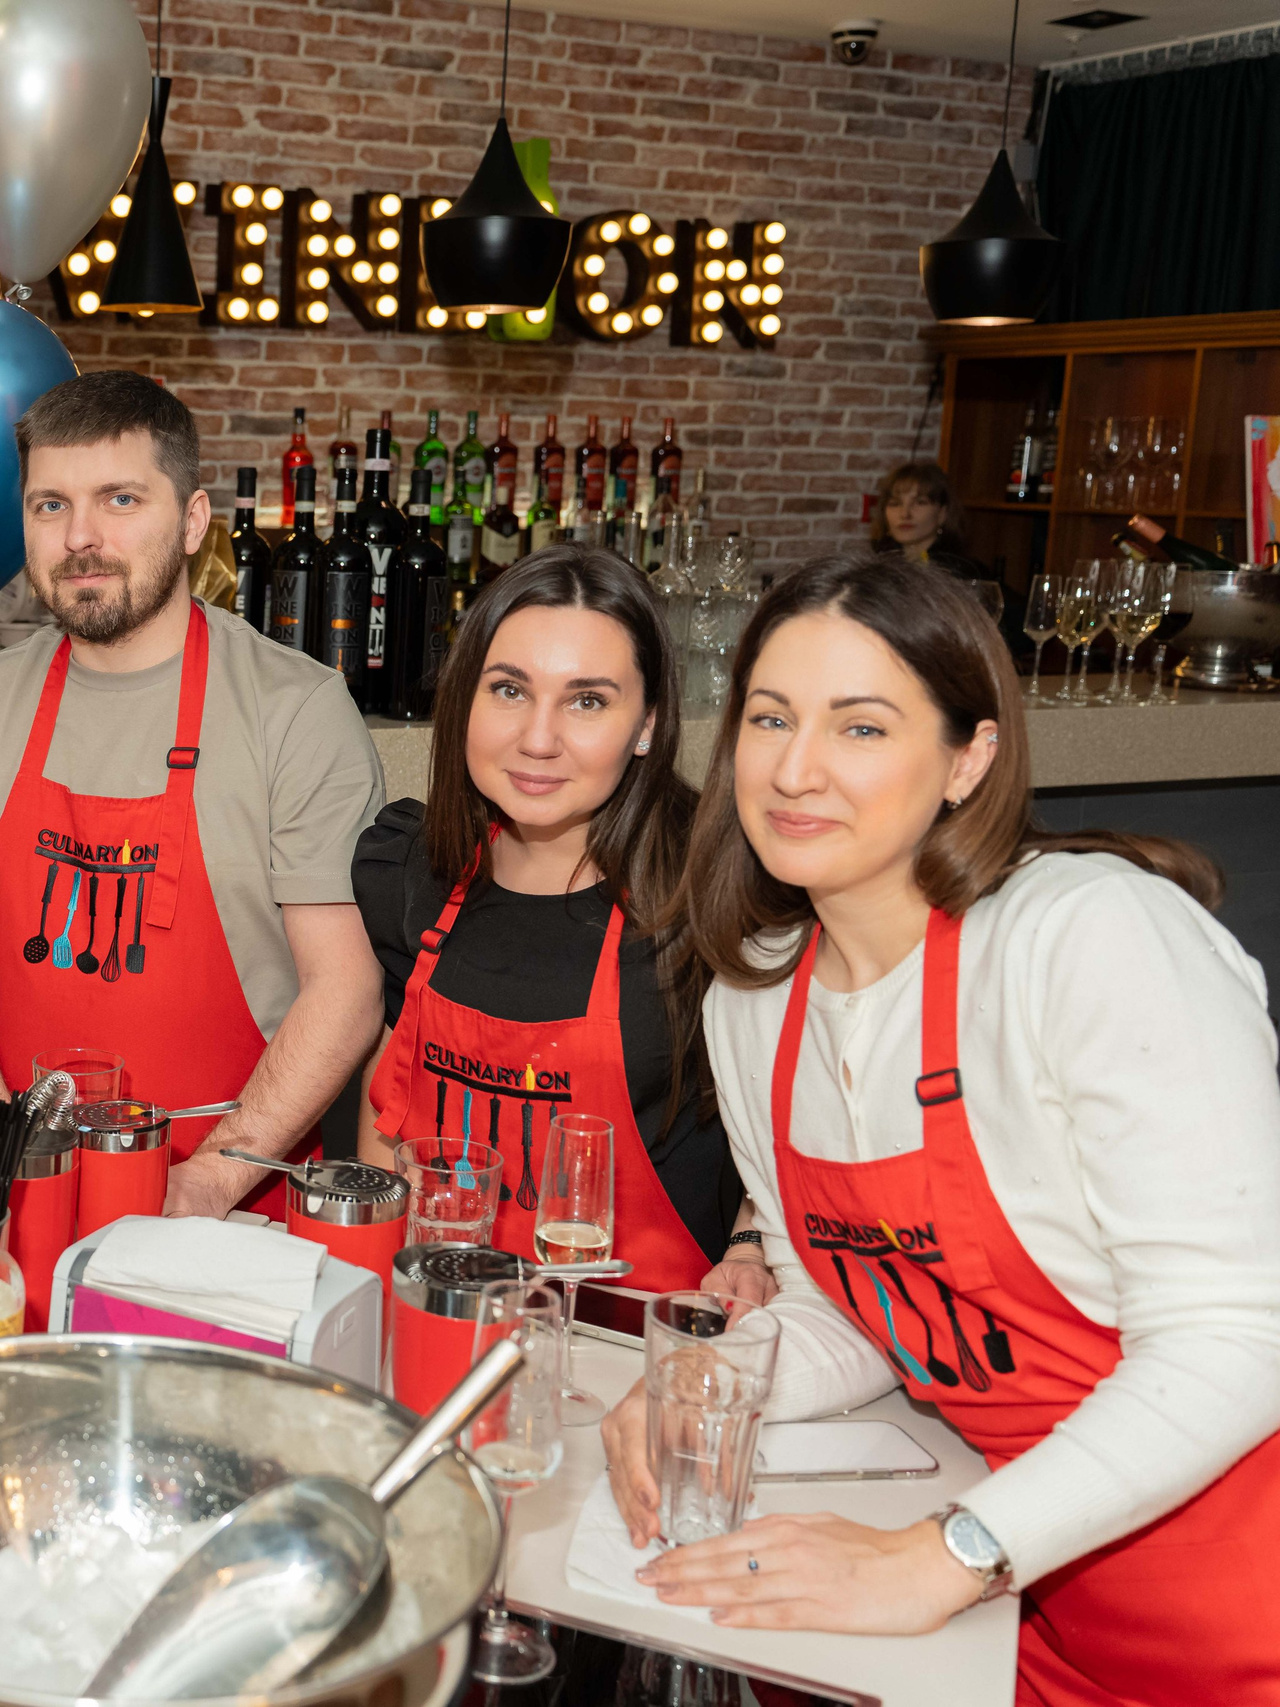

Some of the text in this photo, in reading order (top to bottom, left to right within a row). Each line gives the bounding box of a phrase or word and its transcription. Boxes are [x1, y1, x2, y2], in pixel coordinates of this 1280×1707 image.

[558, 208, 785, 350] ON
[130, 843, 159, 863] ON
[424, 1041, 570, 1090] CULINARY ON
[895, 1221, 938, 1249] ON
